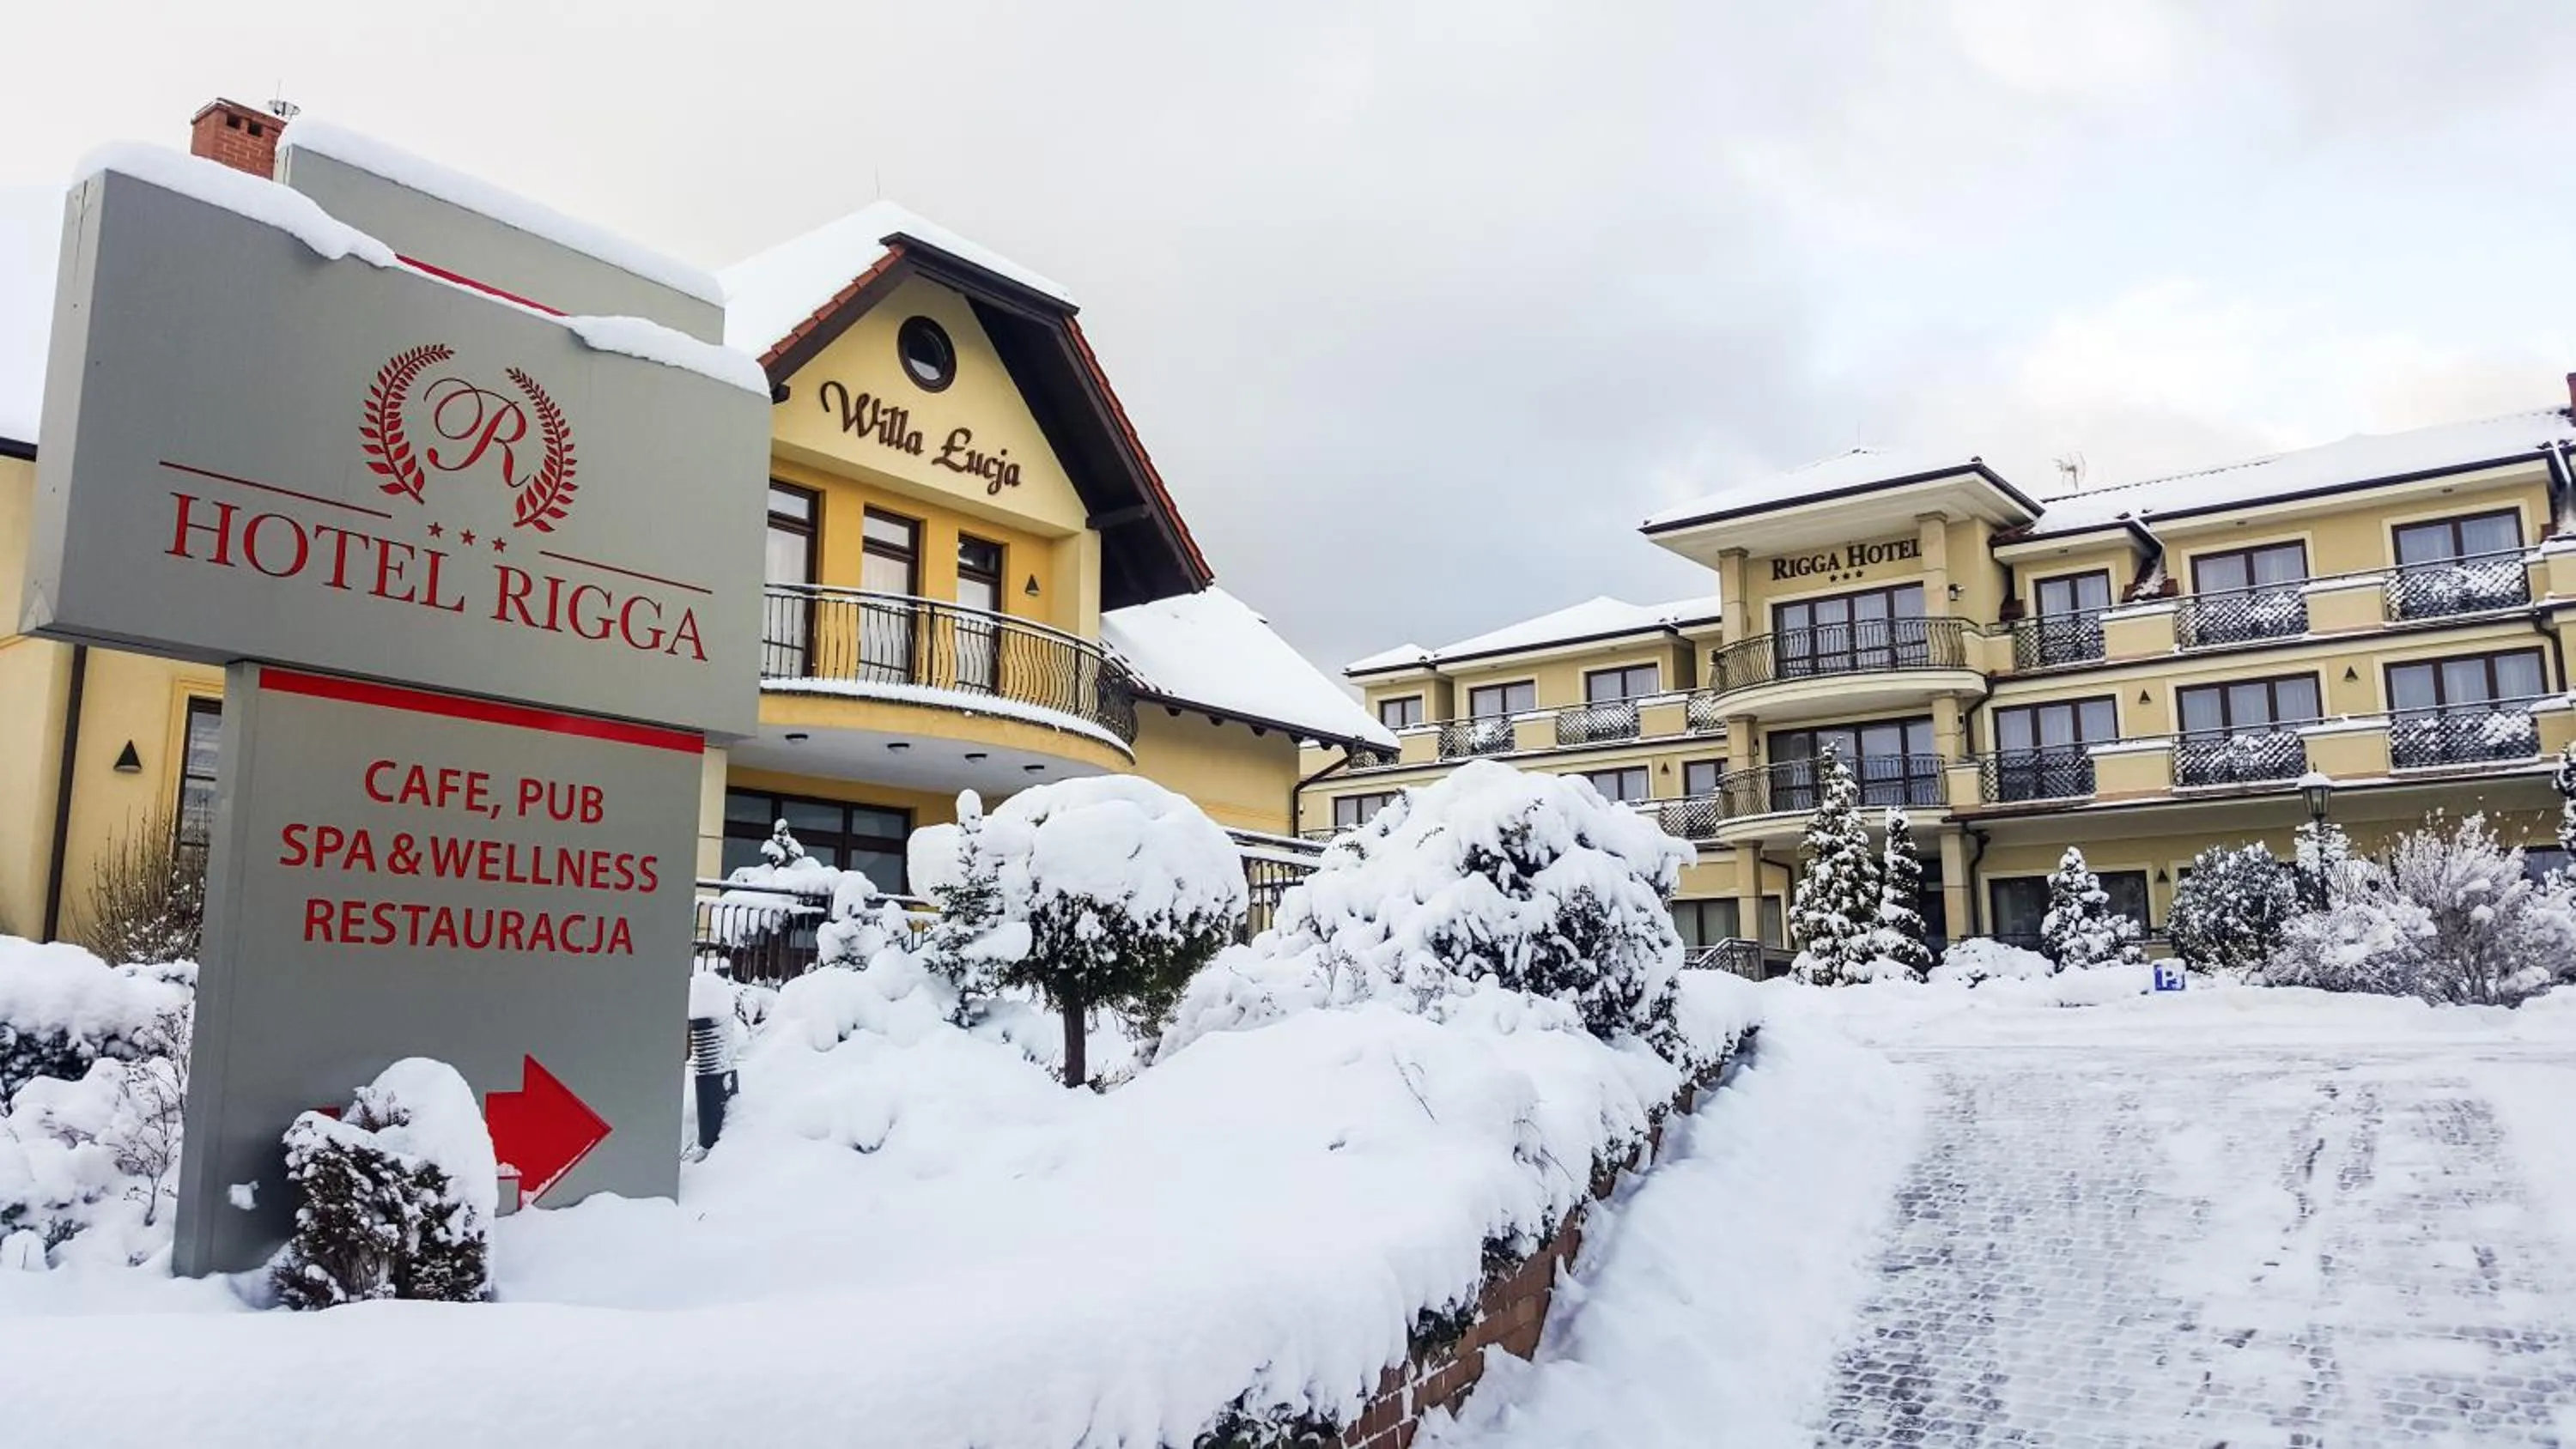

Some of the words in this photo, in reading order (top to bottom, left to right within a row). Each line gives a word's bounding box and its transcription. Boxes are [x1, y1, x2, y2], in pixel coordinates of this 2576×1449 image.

[820, 380, 923, 456] Willa
[166, 493, 465, 613] HOTEL
[491, 564, 707, 661] RIGGA
[1771, 553, 1841, 580] RIGGA
[1846, 538, 1922, 568] HOTEL
[365, 761, 500, 820] CAFE,
[518, 778, 603, 824] PUB
[304, 899, 634, 955] RESTAURACJA
